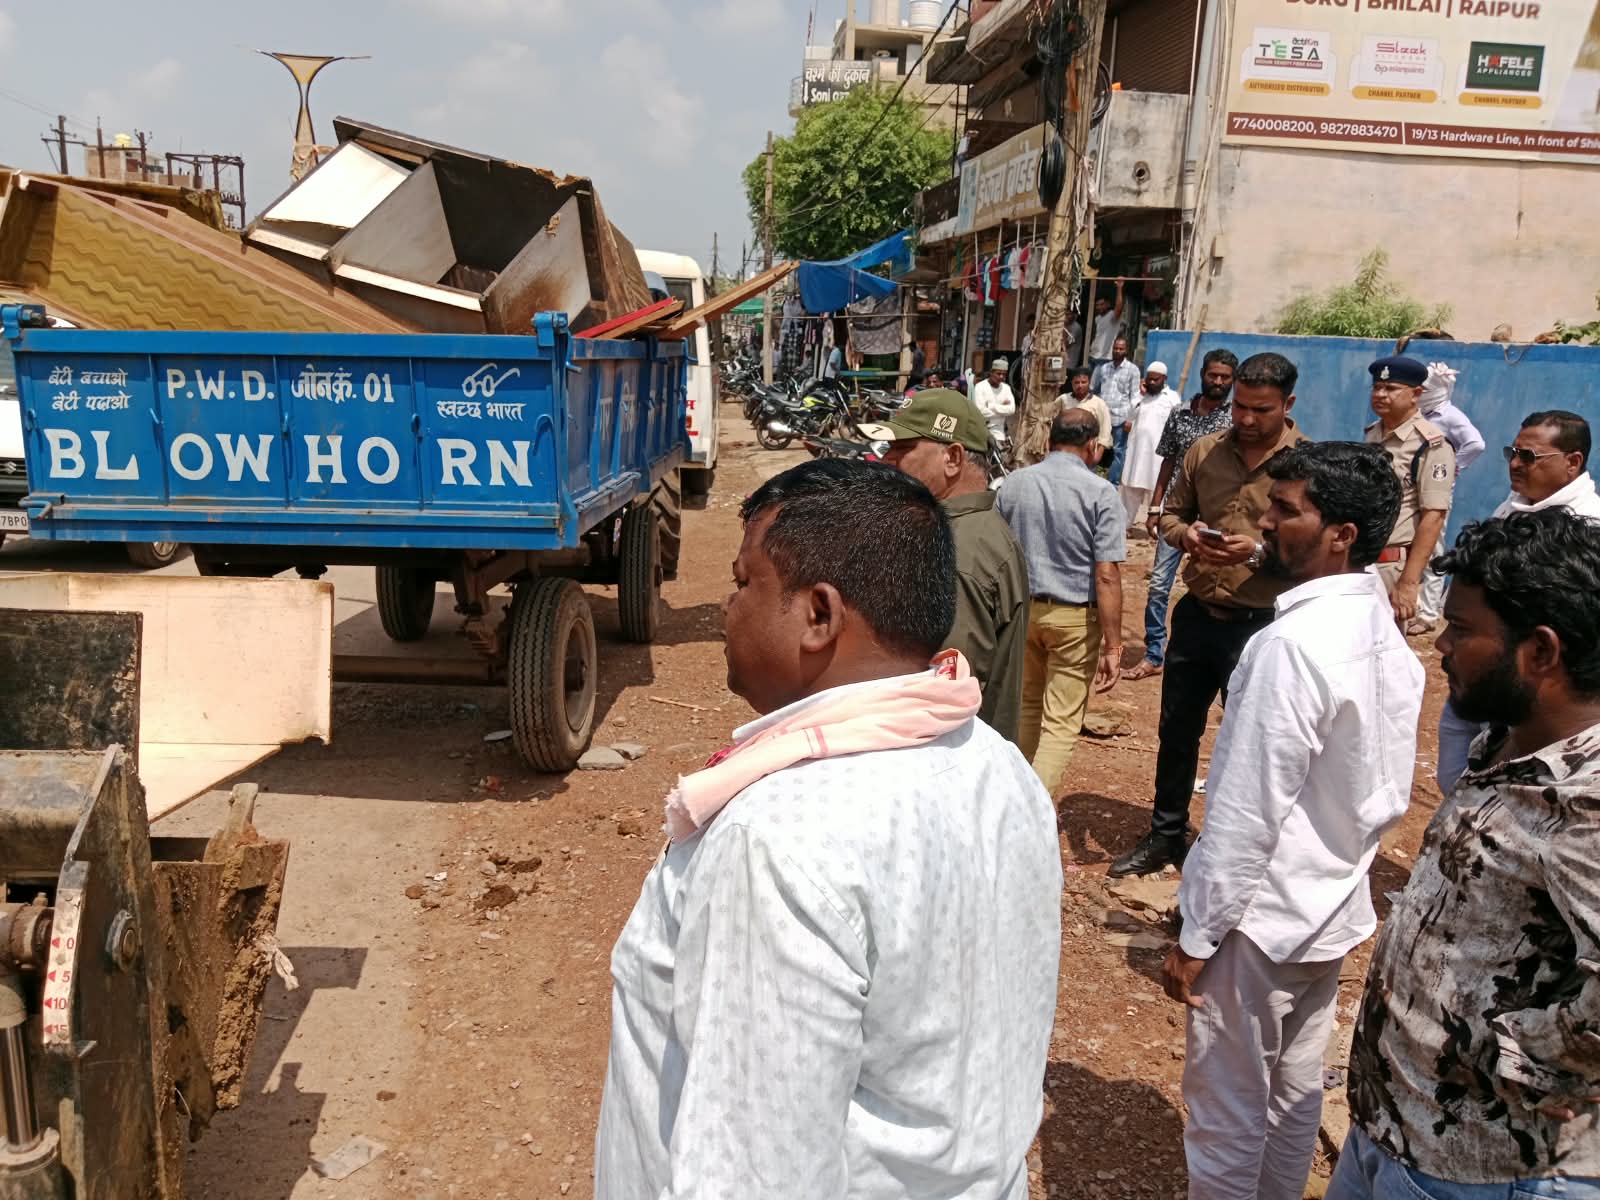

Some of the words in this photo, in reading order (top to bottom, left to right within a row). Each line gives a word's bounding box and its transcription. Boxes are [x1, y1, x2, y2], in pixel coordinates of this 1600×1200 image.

[1459, 0, 1541, 19] RAIPUR
[1259, 43, 1320, 61] TESA
[843, 69, 870, 89] दुकान
[1476, 68, 1532, 77] APPLIANCES
[811, 87, 831, 102] Soni
[1368, 89, 1394, 98] CHANNEL
[1395, 91, 1421, 100] PARTNER
[1233, 117, 1317, 135] 7740008200,
[1320, 124, 1398, 138] 9827883470
[1412, 128, 1438, 140] 19/13
[1440, 130, 1494, 143] Hardware
[1496, 133, 1522, 146] Line,
[1538, 135, 1564, 147] front
[1567, 137, 1578, 148] of
[48, 366, 74, 386] बेटी
[80, 368, 128, 387] बचाओ
[363, 372, 395, 403] 01
[52, 390, 81, 411] बेटी
[437, 400, 482, 420] स्वच्छ
[486, 403, 527, 421] भारत
[66, 937, 75, 950] 0
[62, 970, 71, 983] 5
[53, 998, 67, 1010] 10
